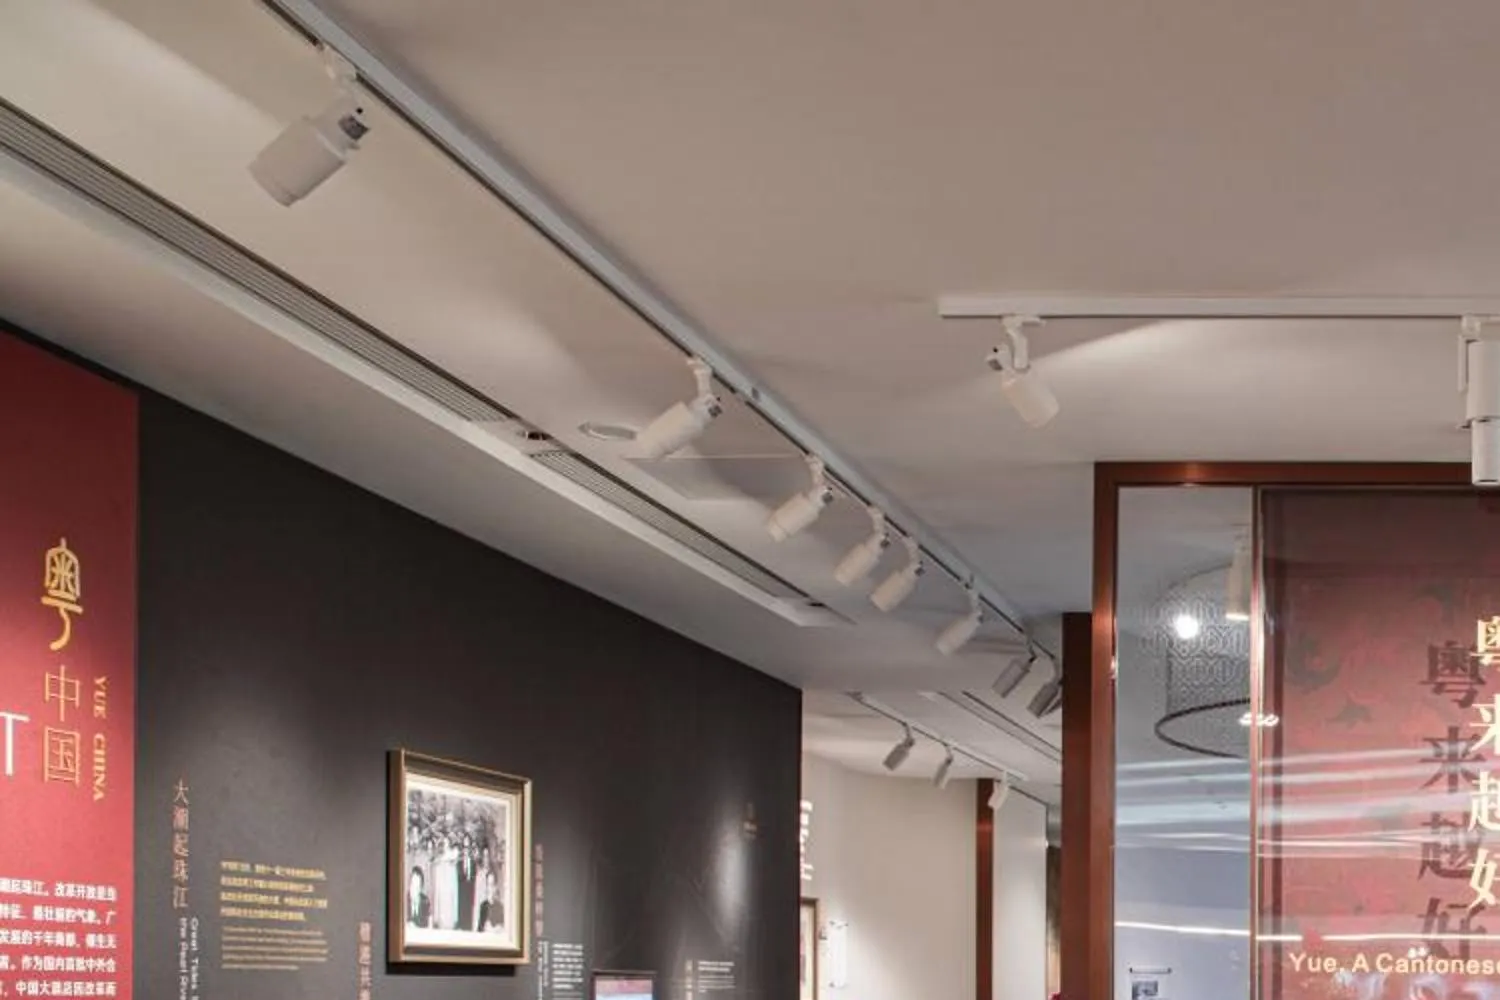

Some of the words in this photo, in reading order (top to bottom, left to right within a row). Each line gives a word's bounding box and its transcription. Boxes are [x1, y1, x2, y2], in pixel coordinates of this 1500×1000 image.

[93, 675, 107, 718] YUE
[93, 733, 106, 801] CHINA
[1289, 953, 1345, 977] Yue,
[1351, 954, 1370, 973] A
